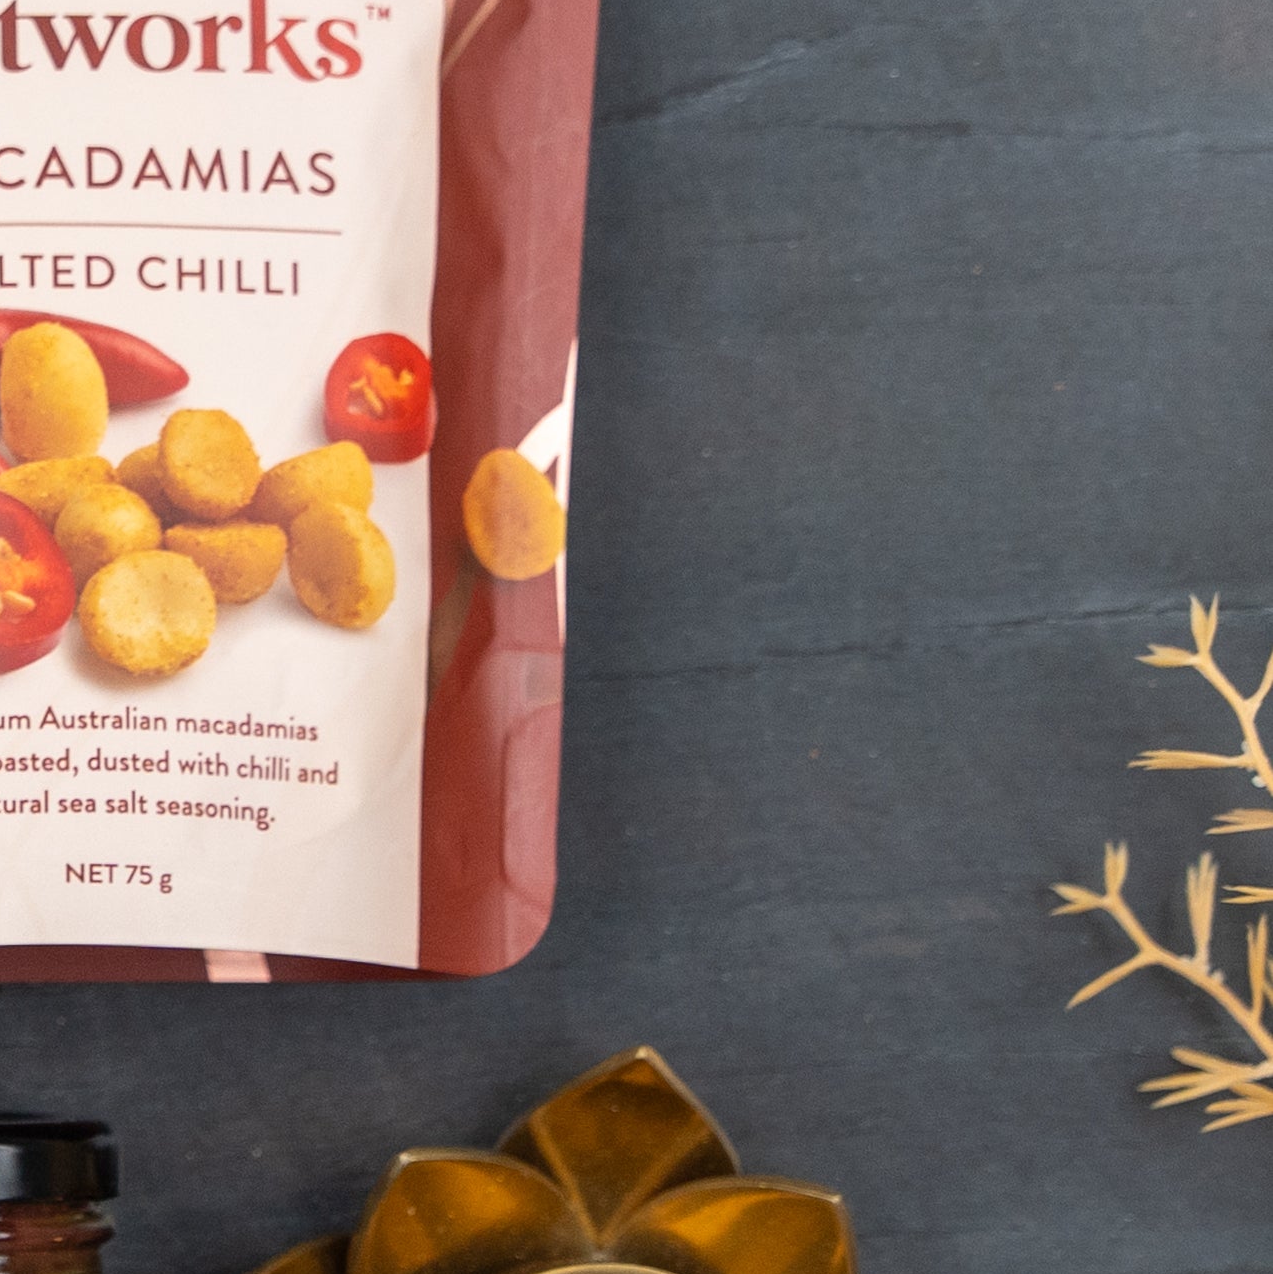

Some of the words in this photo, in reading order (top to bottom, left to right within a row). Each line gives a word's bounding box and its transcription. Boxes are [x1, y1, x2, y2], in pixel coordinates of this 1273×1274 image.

[138, 257, 301, 296] CHILLI
[40, 706, 167, 733] Australian
[176, 714, 319, 743] macadamias
[87, 749, 170, 776] dusted
[177, 752, 229, 778] with
[236, 756, 291, 784] chilli
[297, 760, 339, 787] and
[57, 796, 97, 815] sea
[105, 790, 148, 816] salt
[155, 797, 276, 831] seasoning.
[65, 861, 117, 886] NET
